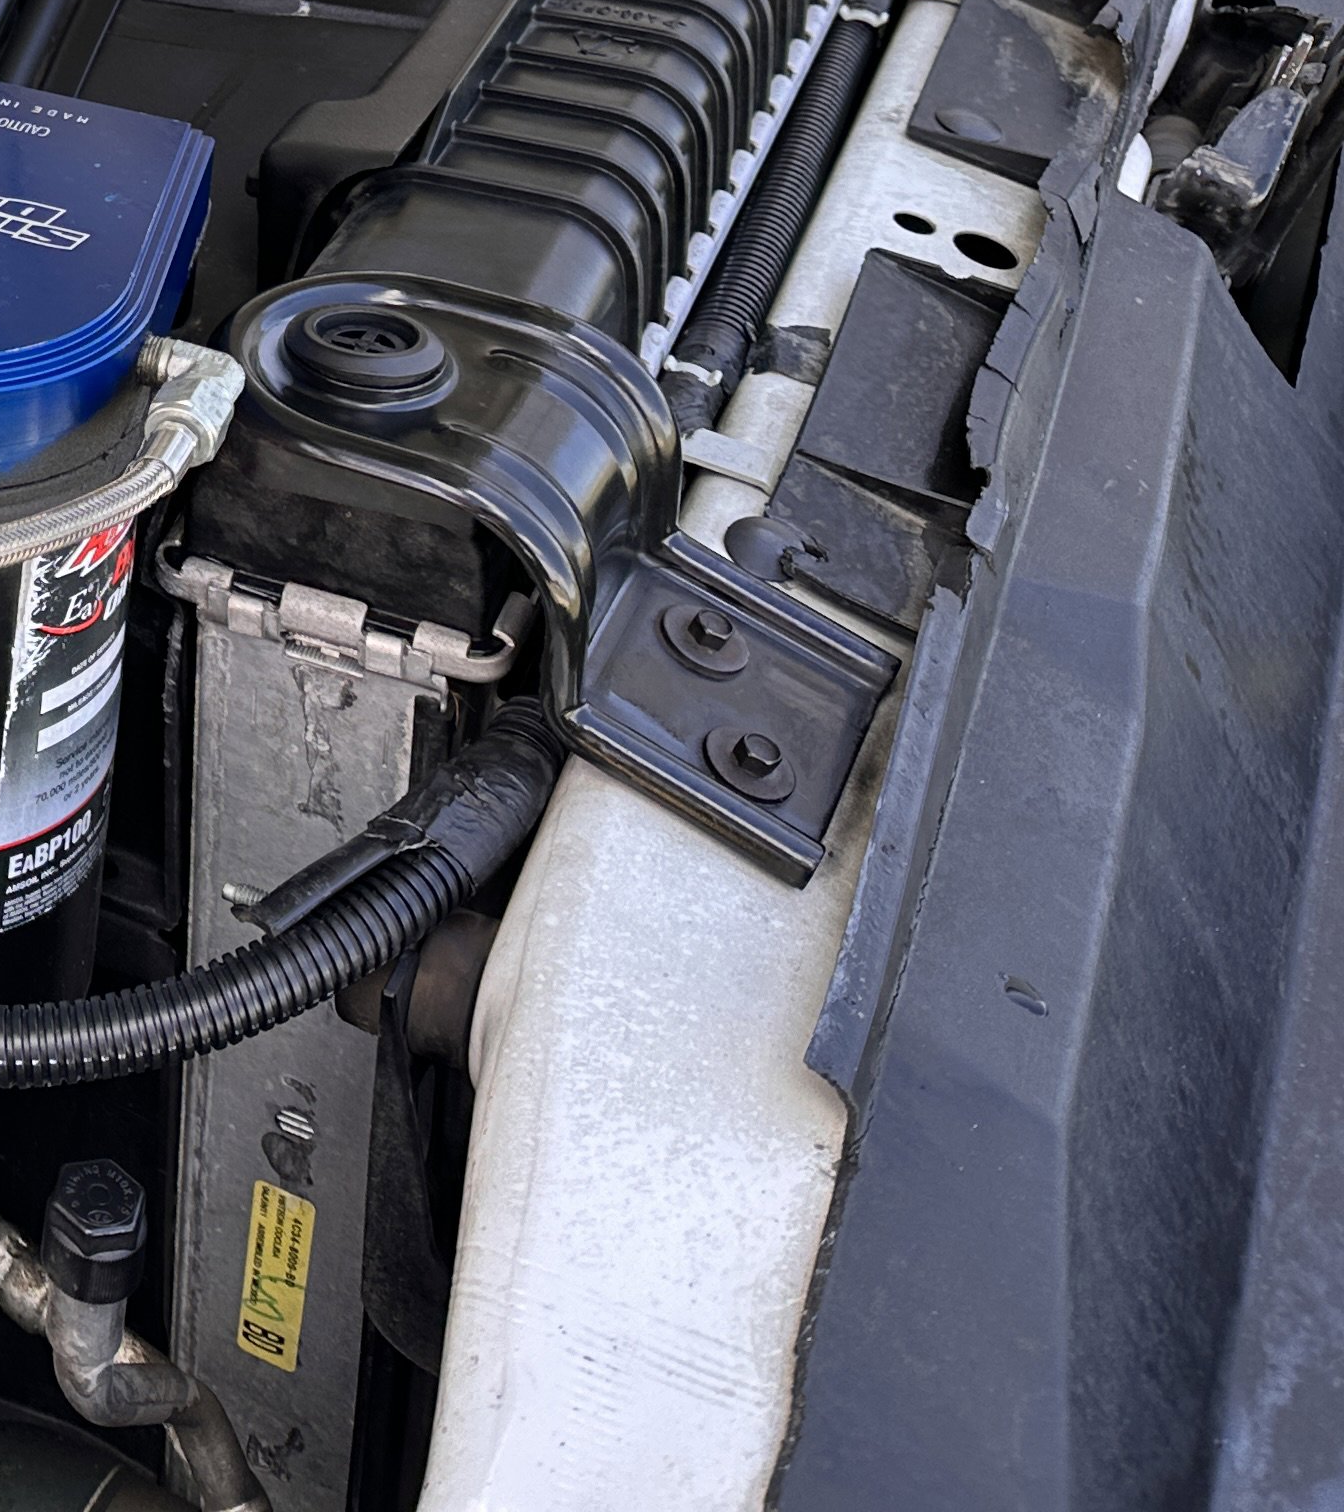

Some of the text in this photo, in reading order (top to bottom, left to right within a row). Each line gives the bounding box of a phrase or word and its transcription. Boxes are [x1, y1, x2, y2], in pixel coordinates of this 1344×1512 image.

[0, 98, 20, 108] IN
[31, 105, 89, 124] MADE
[240, 1319, 286, 1356] BD
